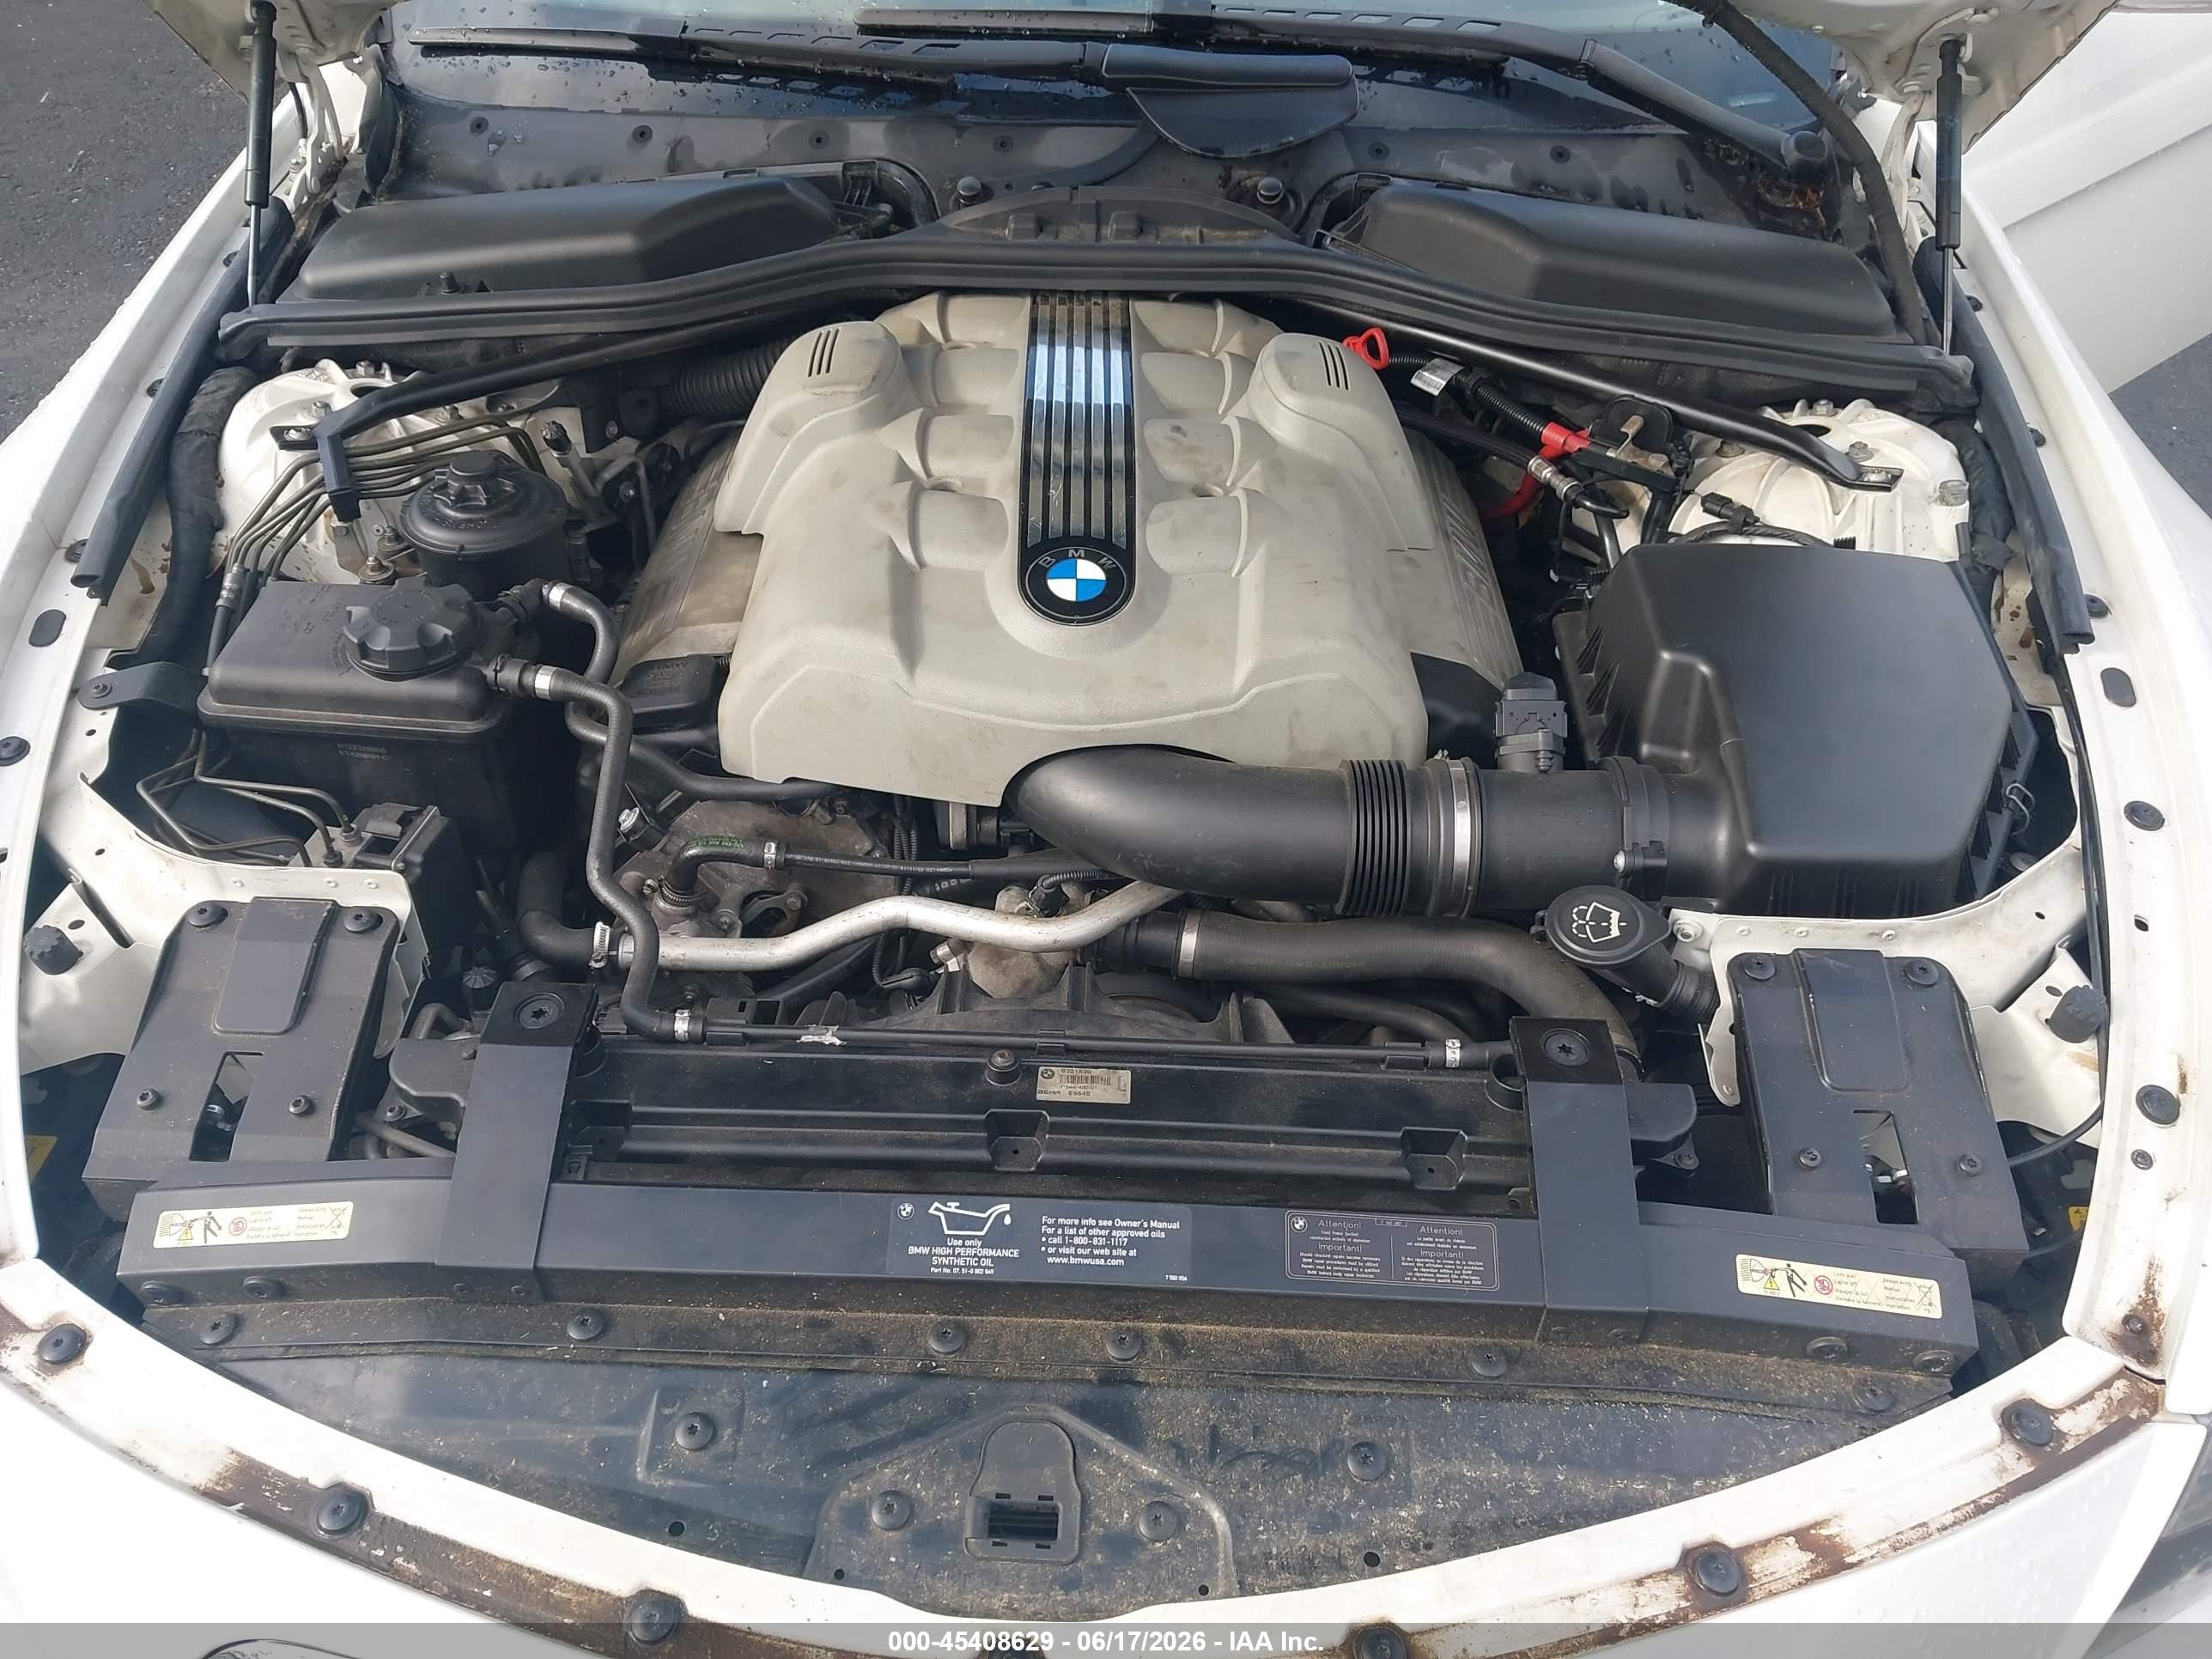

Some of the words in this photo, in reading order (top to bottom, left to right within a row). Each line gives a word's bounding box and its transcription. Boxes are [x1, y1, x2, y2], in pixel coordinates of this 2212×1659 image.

[1038, 550, 1115, 569] BMW
[1042, 1215, 1056, 1226] For
[1057, 1218, 1079, 1227] more
[1081, 1218, 1096, 1228] info
[1114, 1218, 1148, 1228] Owner's
[1150, 1219, 1180, 1229] Manual
[1318, 1219, 1361, 1231] Attention!
[1042, 1225, 1055, 1234] For
[1056, 1228, 1062, 1237] a
[1064, 1225, 1078, 1237] list
[1078, 1226, 1087, 1237] of
[1088, 1227, 1110, 1238] other
[1111, 1229, 1149, 1239] approved
[1151, 1229, 1165, 1238] oils
[1419, 1225, 1462, 1236] Attention!
[947, 1237, 962, 1247] Use
[963, 1238, 982, 1249] only
[1048, 1237, 1063, 1245] call
[1064, 1237, 1128, 1247] 1-800-831-1117
[1318, 1242, 1362, 1252] Important!
[908, 1245, 931, 1255] BMW
[932, 1246, 954, 1258] HIGH
[954, 1247, 1019, 1258] PERFORMANCE
[1058, 1245, 1075, 1256] visit
[1092, 1247, 1110, 1255] web
[1111, 1248, 1127, 1256] site
[1420, 1249, 1465, 1259] Important!
[932, 1256, 979, 1266] SYNTHETIC
[980, 1257, 994, 1267] OIL
[1047, 1256, 1124, 1266] www.bmwusa.com
